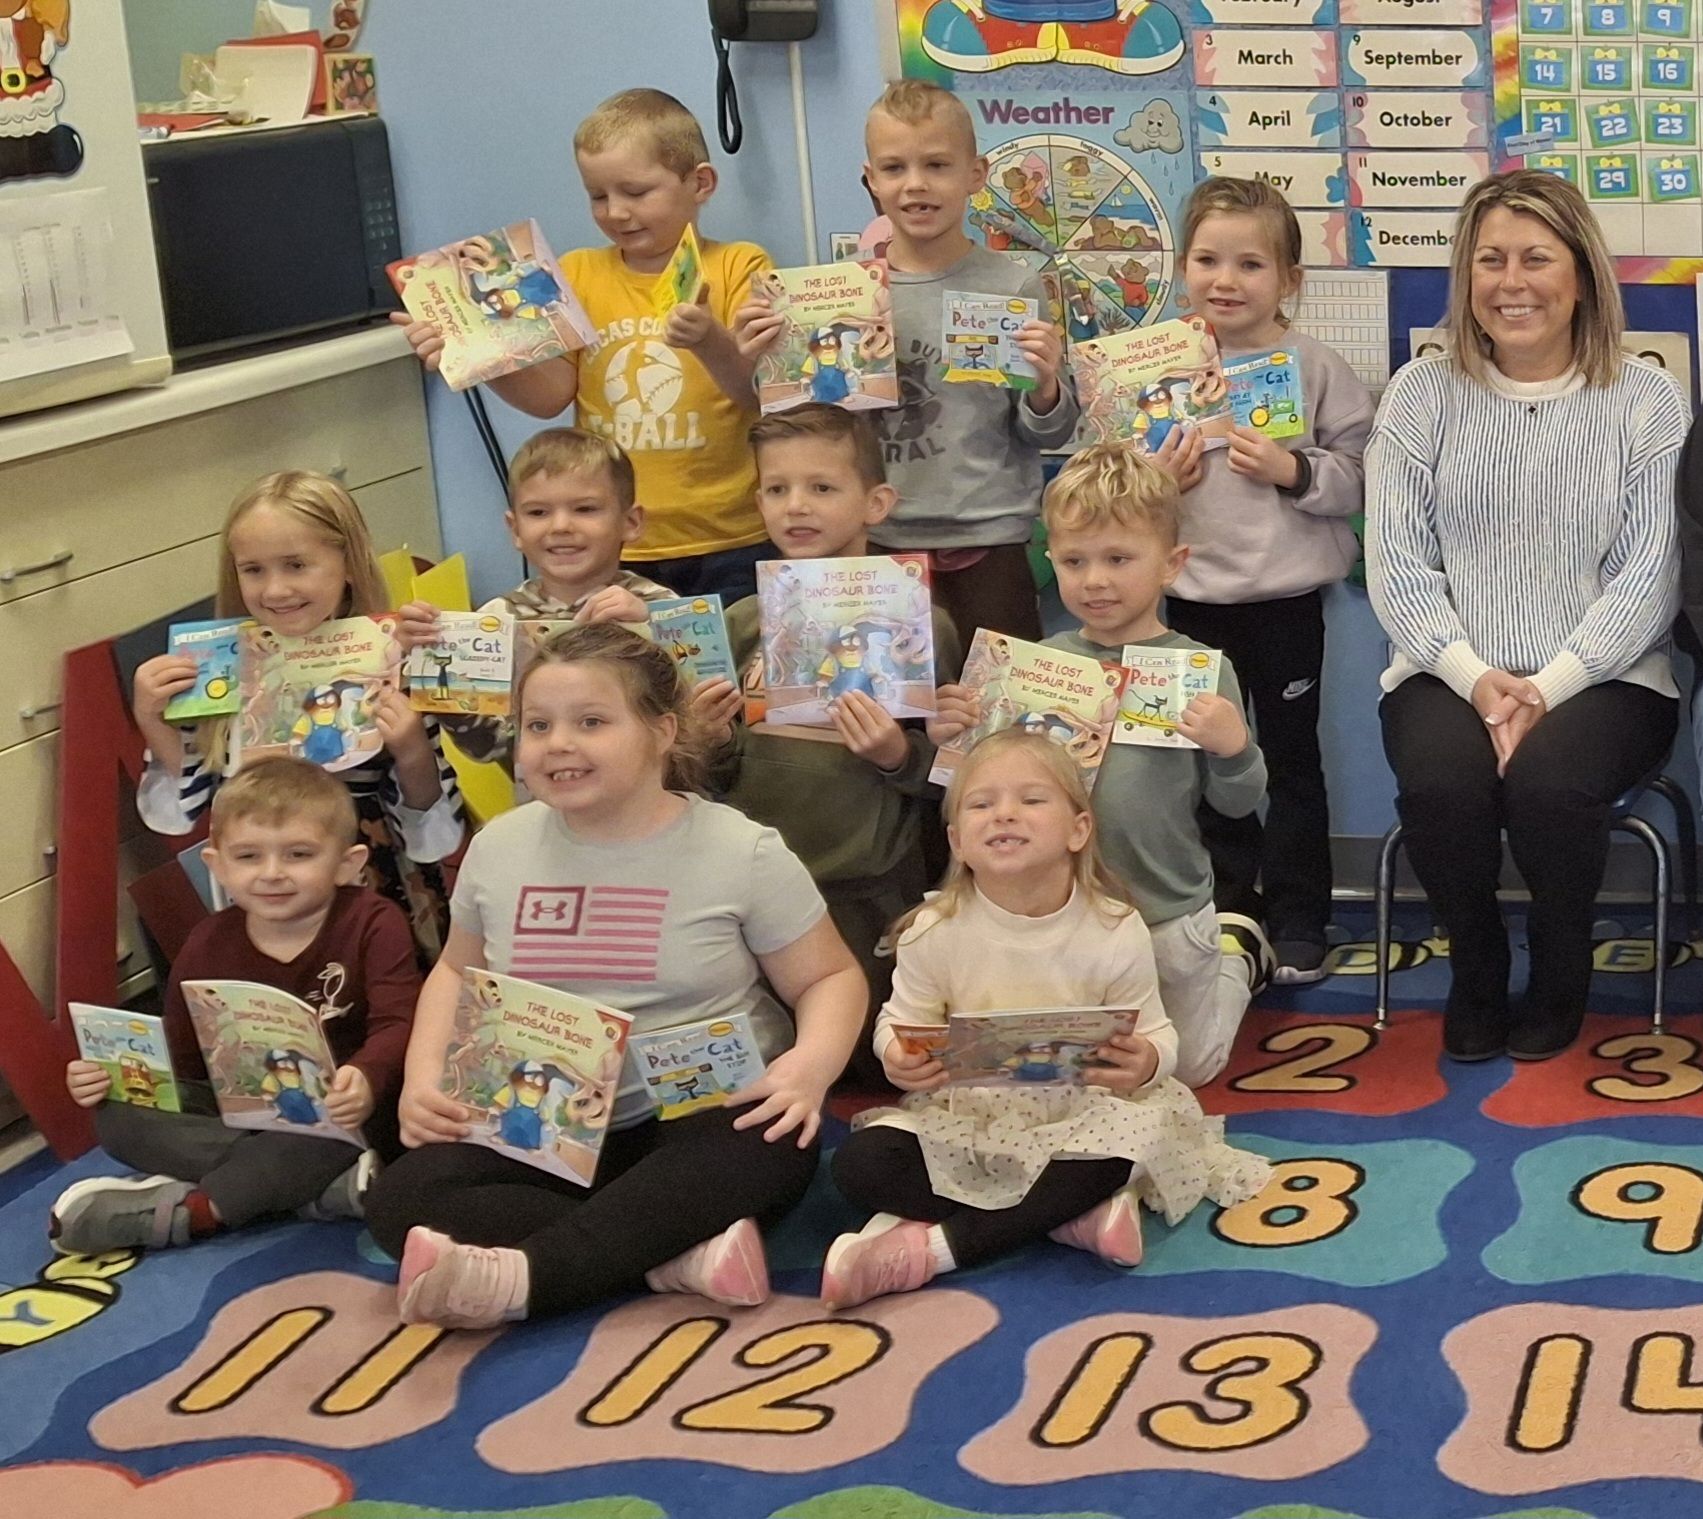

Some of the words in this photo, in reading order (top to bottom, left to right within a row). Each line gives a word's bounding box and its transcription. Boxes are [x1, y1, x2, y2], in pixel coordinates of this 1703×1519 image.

[1541, 10, 1553, 25] 7
[1601, 10, 1615, 25] 8
[1657, 10, 1670, 25] 9
[1205, 35, 1213, 45] 3
[1353, 34, 1361, 45] 9
[1238, 50, 1293, 65] March
[1364, 50, 1462, 69] September
[1535, 65, 1555, 81] 14
[1596, 64, 1616, 80] 15
[1657, 64, 1678, 79] 16
[1209, 95, 1217, 106] 4
[1352, 96, 1364, 108] 10
[978, 98, 1114, 125] Weather
[1379, 111, 1452, 126] October
[1249, 111, 1291, 129] April
[1541, 117, 1562, 132] 21
[1600, 118, 1627, 136] 22
[1657, 118, 1683, 133] 23
[1214, 157, 1222, 167] 5
[1254, 171, 1293, 191] May
[1372, 171, 1466, 186] November
[1600, 171, 1624, 188] 29
[1661, 174, 1687, 190] 30
[1379, 230, 1455, 245] Decemb
[952, 310, 987, 330] Pete
[1125, 338, 1145, 351] THE
[1146, 332, 1171, 346] LOST
[1111, 348, 1162, 367] DINOSAUR
[1163, 339, 1190, 354] BONE
[1265, 371, 1291, 384] Cat
[850, 570, 878, 582] LOST
[472, 637, 502, 653] Cat
[1033, 658, 1053, 673] THE
[1055, 663, 1083, 678] LOST
[1010, 666, 1065, 690] DINOSAUR
[1067, 680, 1095, 697] BONE
[1131, 668, 1167, 687] Pete
[1182, 673, 1209, 689] Cat
[526, 1001, 548, 1018] THE
[550, 1008, 580, 1025] LOST
[503, 1010, 561, 1037] DINOSAUR
[564, 1029, 593, 1050] BONE
[648, 1051, 691, 1070] Pete
[707, 1039, 743, 1057] Cat
[1230, 1022, 1378, 1094] 2
[1212, 1157, 1366, 1247] 8
[170, 1306, 446, 1416] 11
[578, 1316, 892, 1434] 12
[1031, 1331, 1323, 1452] 13
